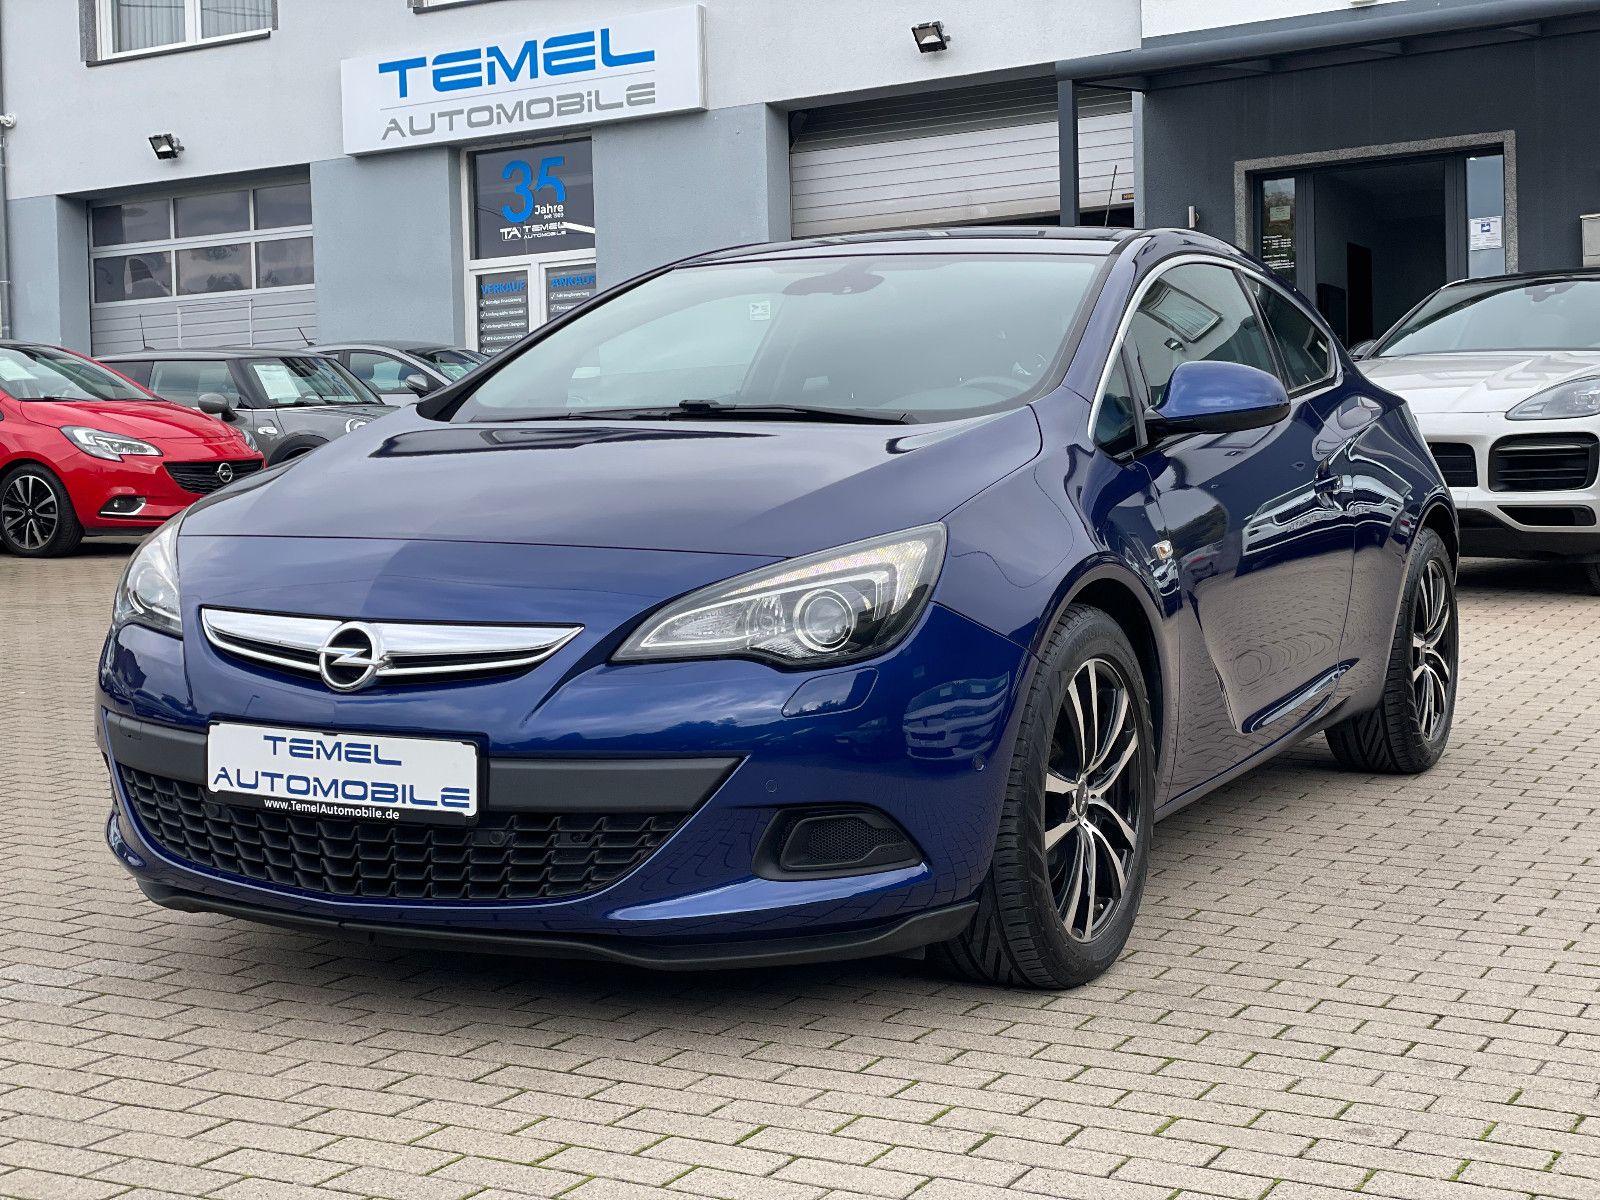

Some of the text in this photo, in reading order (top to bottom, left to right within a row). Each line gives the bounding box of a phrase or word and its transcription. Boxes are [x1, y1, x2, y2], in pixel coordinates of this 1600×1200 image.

[378, 28, 655, 98] TEMEL
[502, 156, 567, 223] 35
[534, 203, 564, 215] Jahre
[481, 280, 526, 295] VERKAUF
[263, 735, 402, 766] TEMEL
[213, 767, 470, 808] AUTOMOBILE
[264, 799, 399, 820] www.TemelAutomobile.de
